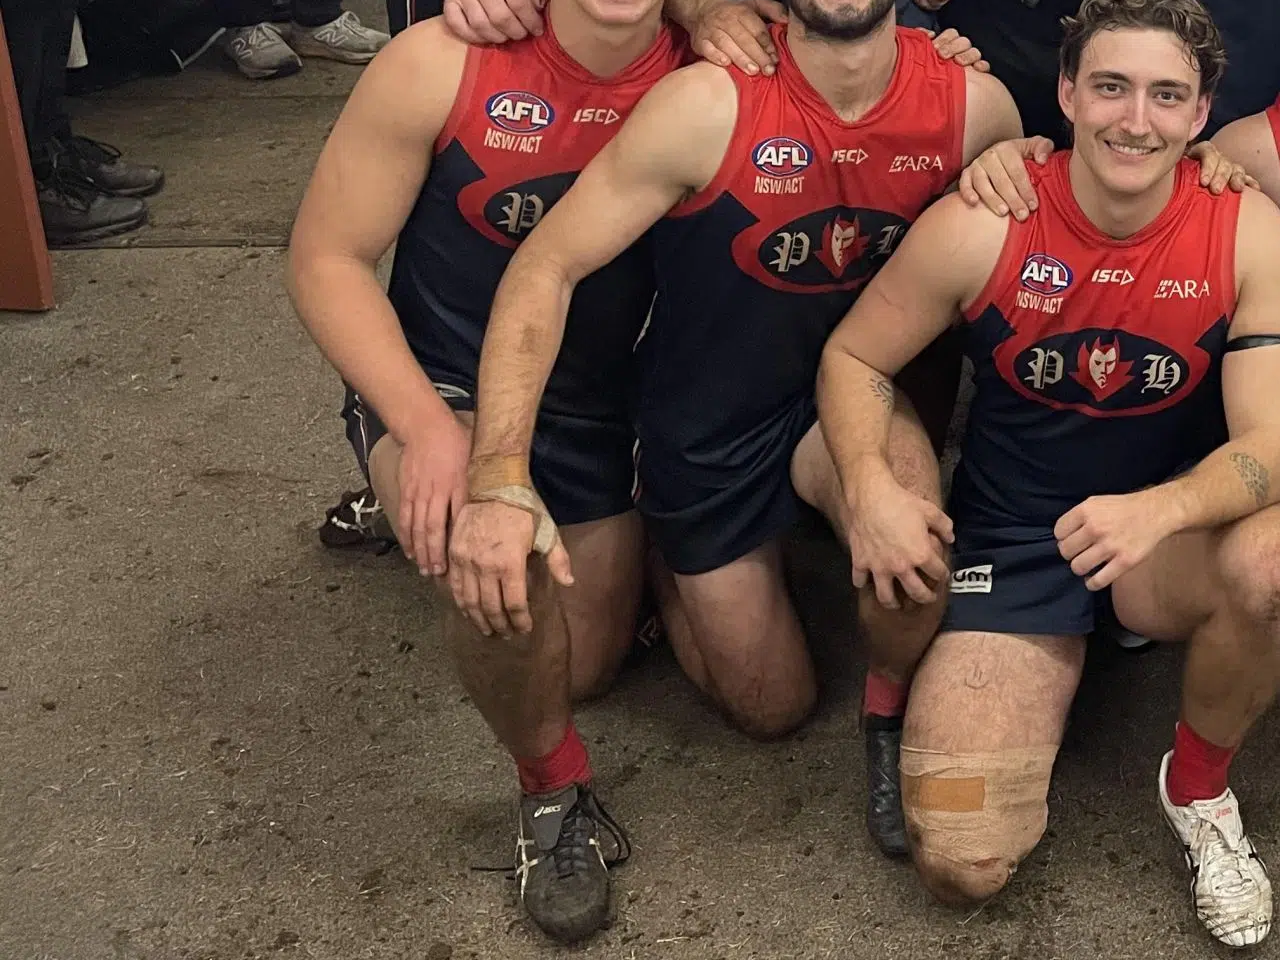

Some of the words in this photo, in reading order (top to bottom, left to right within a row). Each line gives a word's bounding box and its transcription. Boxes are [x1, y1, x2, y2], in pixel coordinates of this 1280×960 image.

[489, 98, 549, 126] AFL
[484, 127, 543, 154] NSW/ACT
[757, 146, 808, 166] AFL
[754, 176, 805, 194] NSW/ACT
[1021, 261, 1068, 287] AFL
[1015, 290, 1064, 314] NSW/ACT
